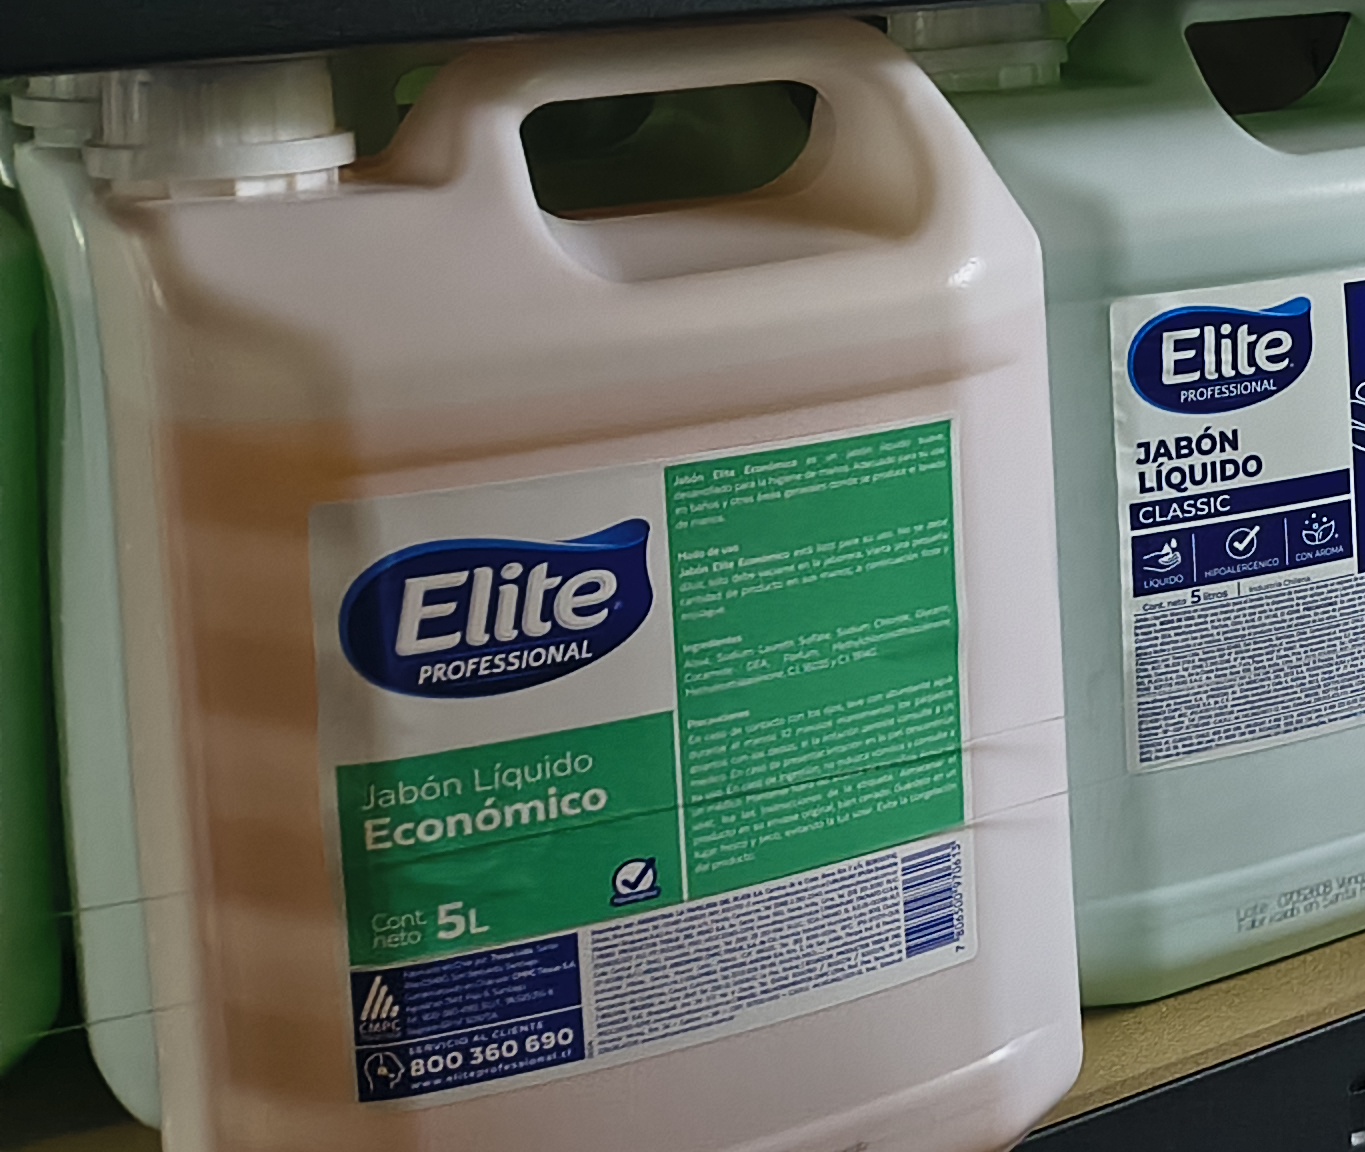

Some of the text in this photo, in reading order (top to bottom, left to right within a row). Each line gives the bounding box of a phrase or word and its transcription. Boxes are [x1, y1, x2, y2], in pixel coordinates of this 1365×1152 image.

[1161, 323, 1294, 385] Elite
[1180, 379, 1277, 403] PROFESSIONAL
[1136, 426, 1239, 465] JABÓN
[1138, 454, 1263, 494] LÍQUIDO
[1139, 494, 1231, 524] CLASSIC
[1315, 545, 1344, 558] AROMA
[395, 562, 618, 656] Elite
[1190, 589, 1201, 603] 5
[418, 640, 593, 685] PROFESSIONAL
[362, 751, 594, 812] Jabón Líquido
[364, 786, 608, 850] Económico
[372, 929, 423, 948] neto
[473, 1032, 489, 1043] AL
[492, 1020, 544, 1038] CLIENTE
[410, 1027, 574, 1077] 800 360 690
